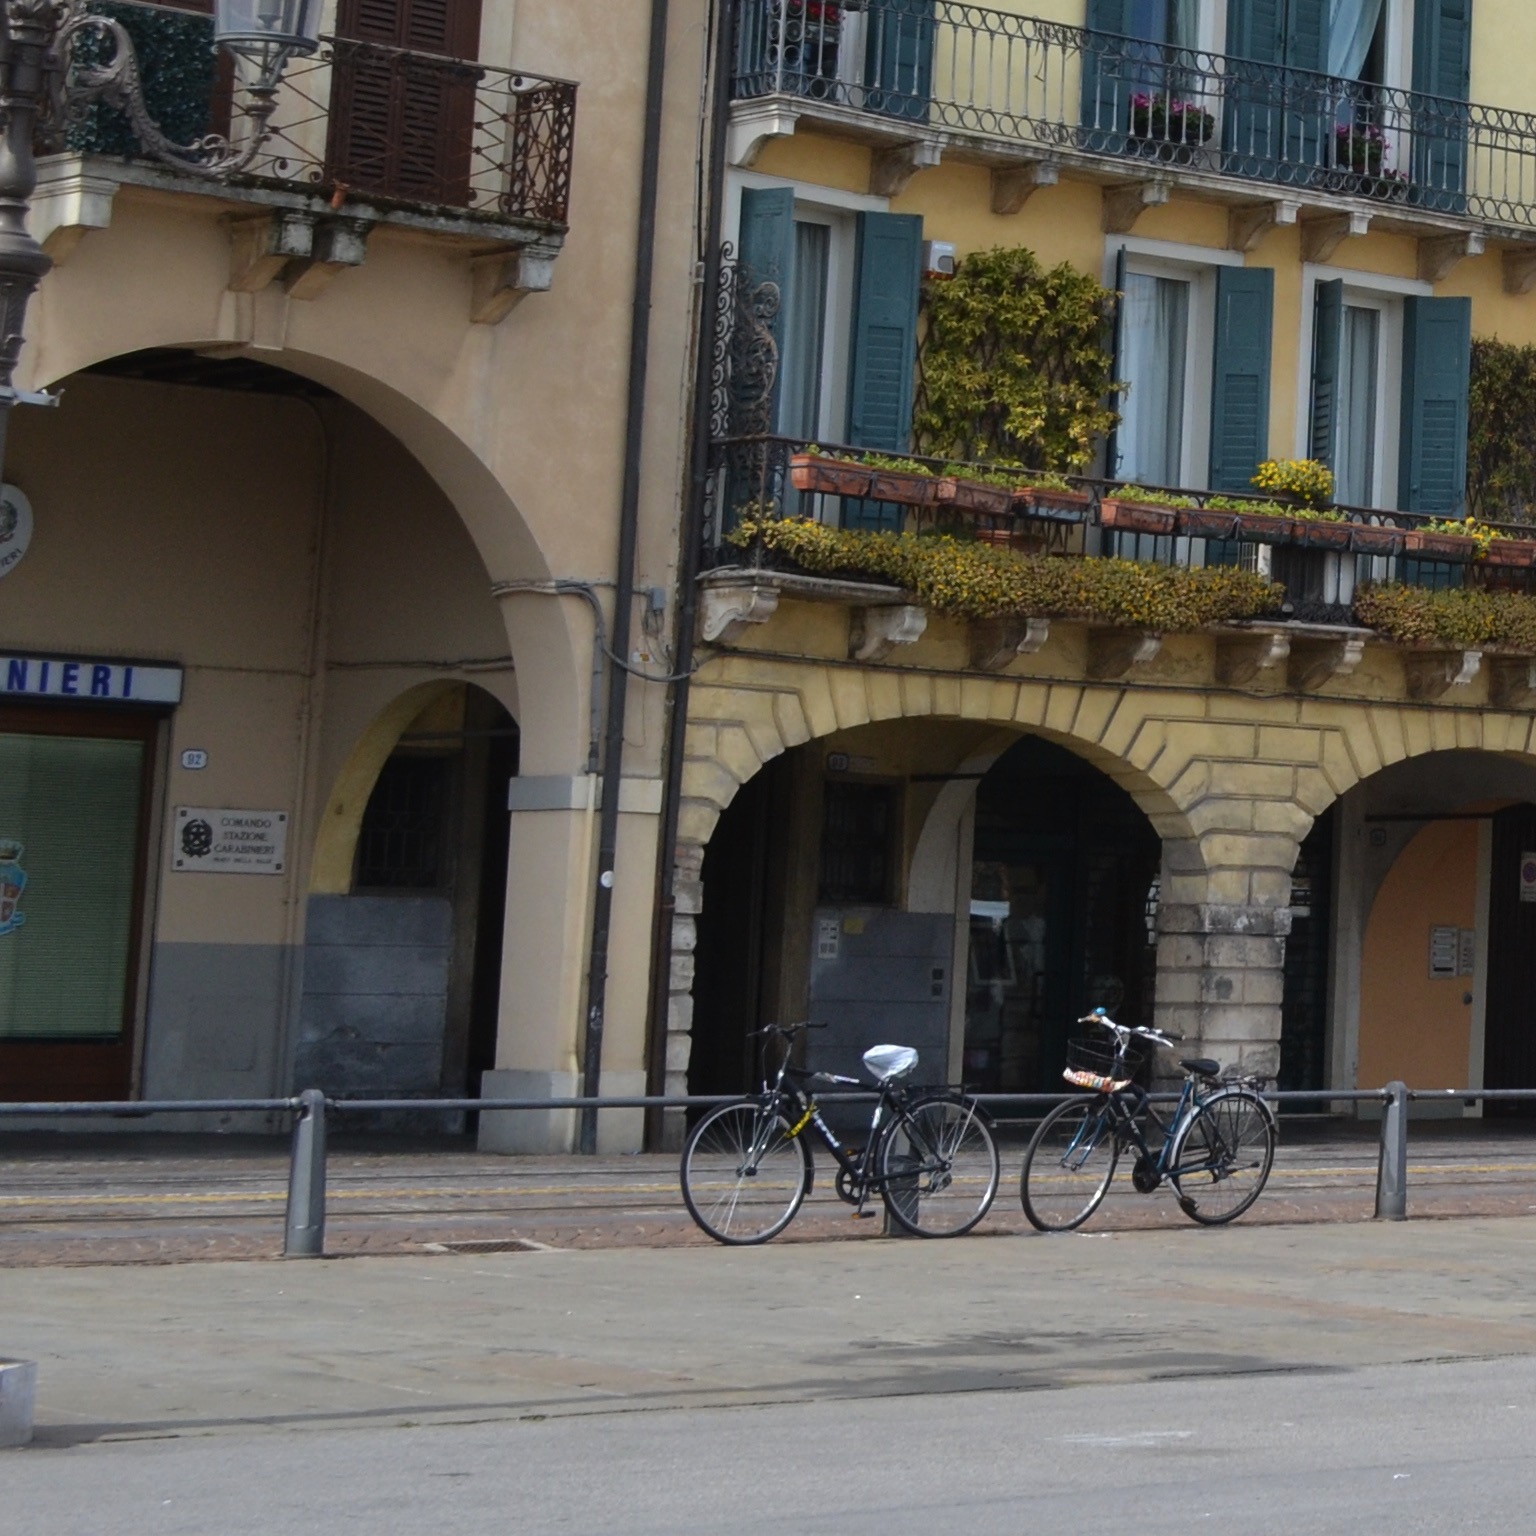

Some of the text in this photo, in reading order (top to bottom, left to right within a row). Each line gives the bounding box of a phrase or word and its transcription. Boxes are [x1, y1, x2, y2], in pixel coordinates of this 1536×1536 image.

[7, 659, 133, 697] NIERI
[187, 754, 202, 765] 92
[221, 817, 272, 828] COMANDO
[223, 831, 267, 841] STAZIONE
[214, 843, 275, 855] CARABINIERI
